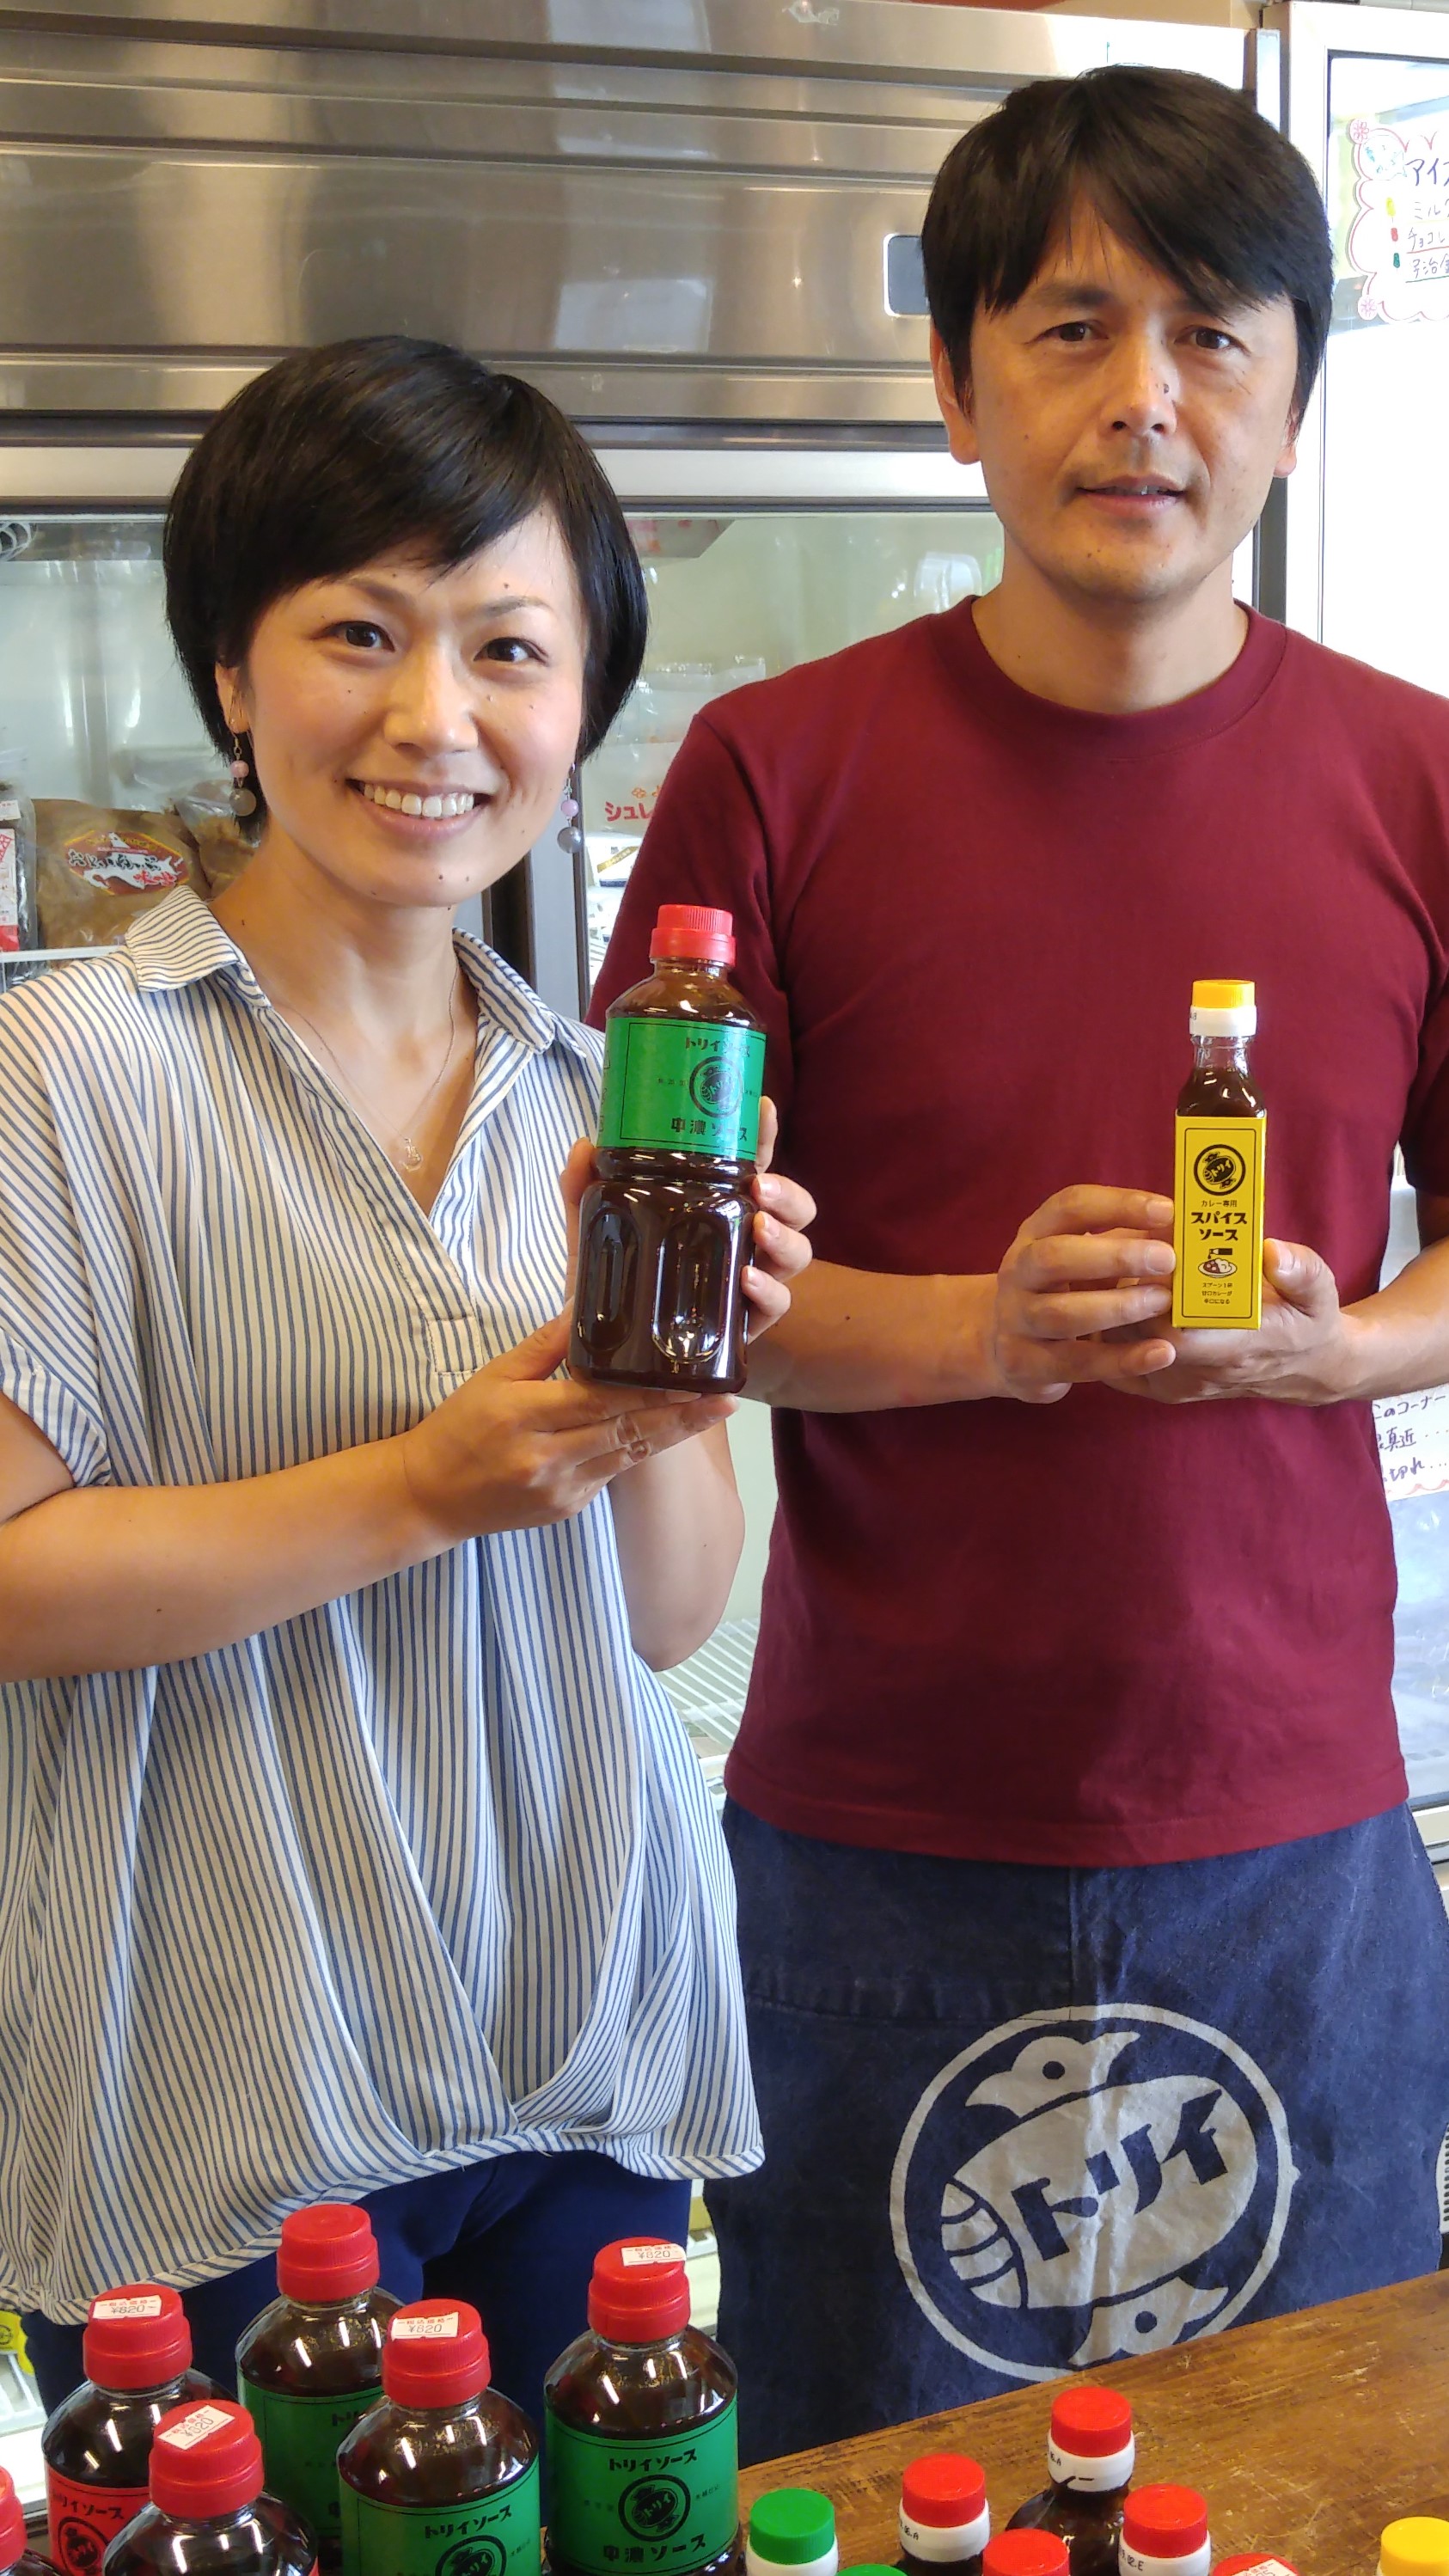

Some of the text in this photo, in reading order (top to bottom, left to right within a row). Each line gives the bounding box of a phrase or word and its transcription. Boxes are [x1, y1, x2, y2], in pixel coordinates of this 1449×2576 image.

[1211, 1159, 1232, 1178] トリイ
[1190, 1210, 1248, 1225] スパイス
[1199, 1228, 1238, 1241] ソース
[1011, 2089, 1228, 2261] トリイ
[638, 2249, 670, 2260] ¥820
[111, 2304, 145, 2314] ¥820
[408, 2323, 443, 2334] ¥820
[609, 2448, 697, 2472] トリイソース
[425, 2504, 511, 2539] トリイソース
[603, 2533, 706, 2563] 中濃ソース
